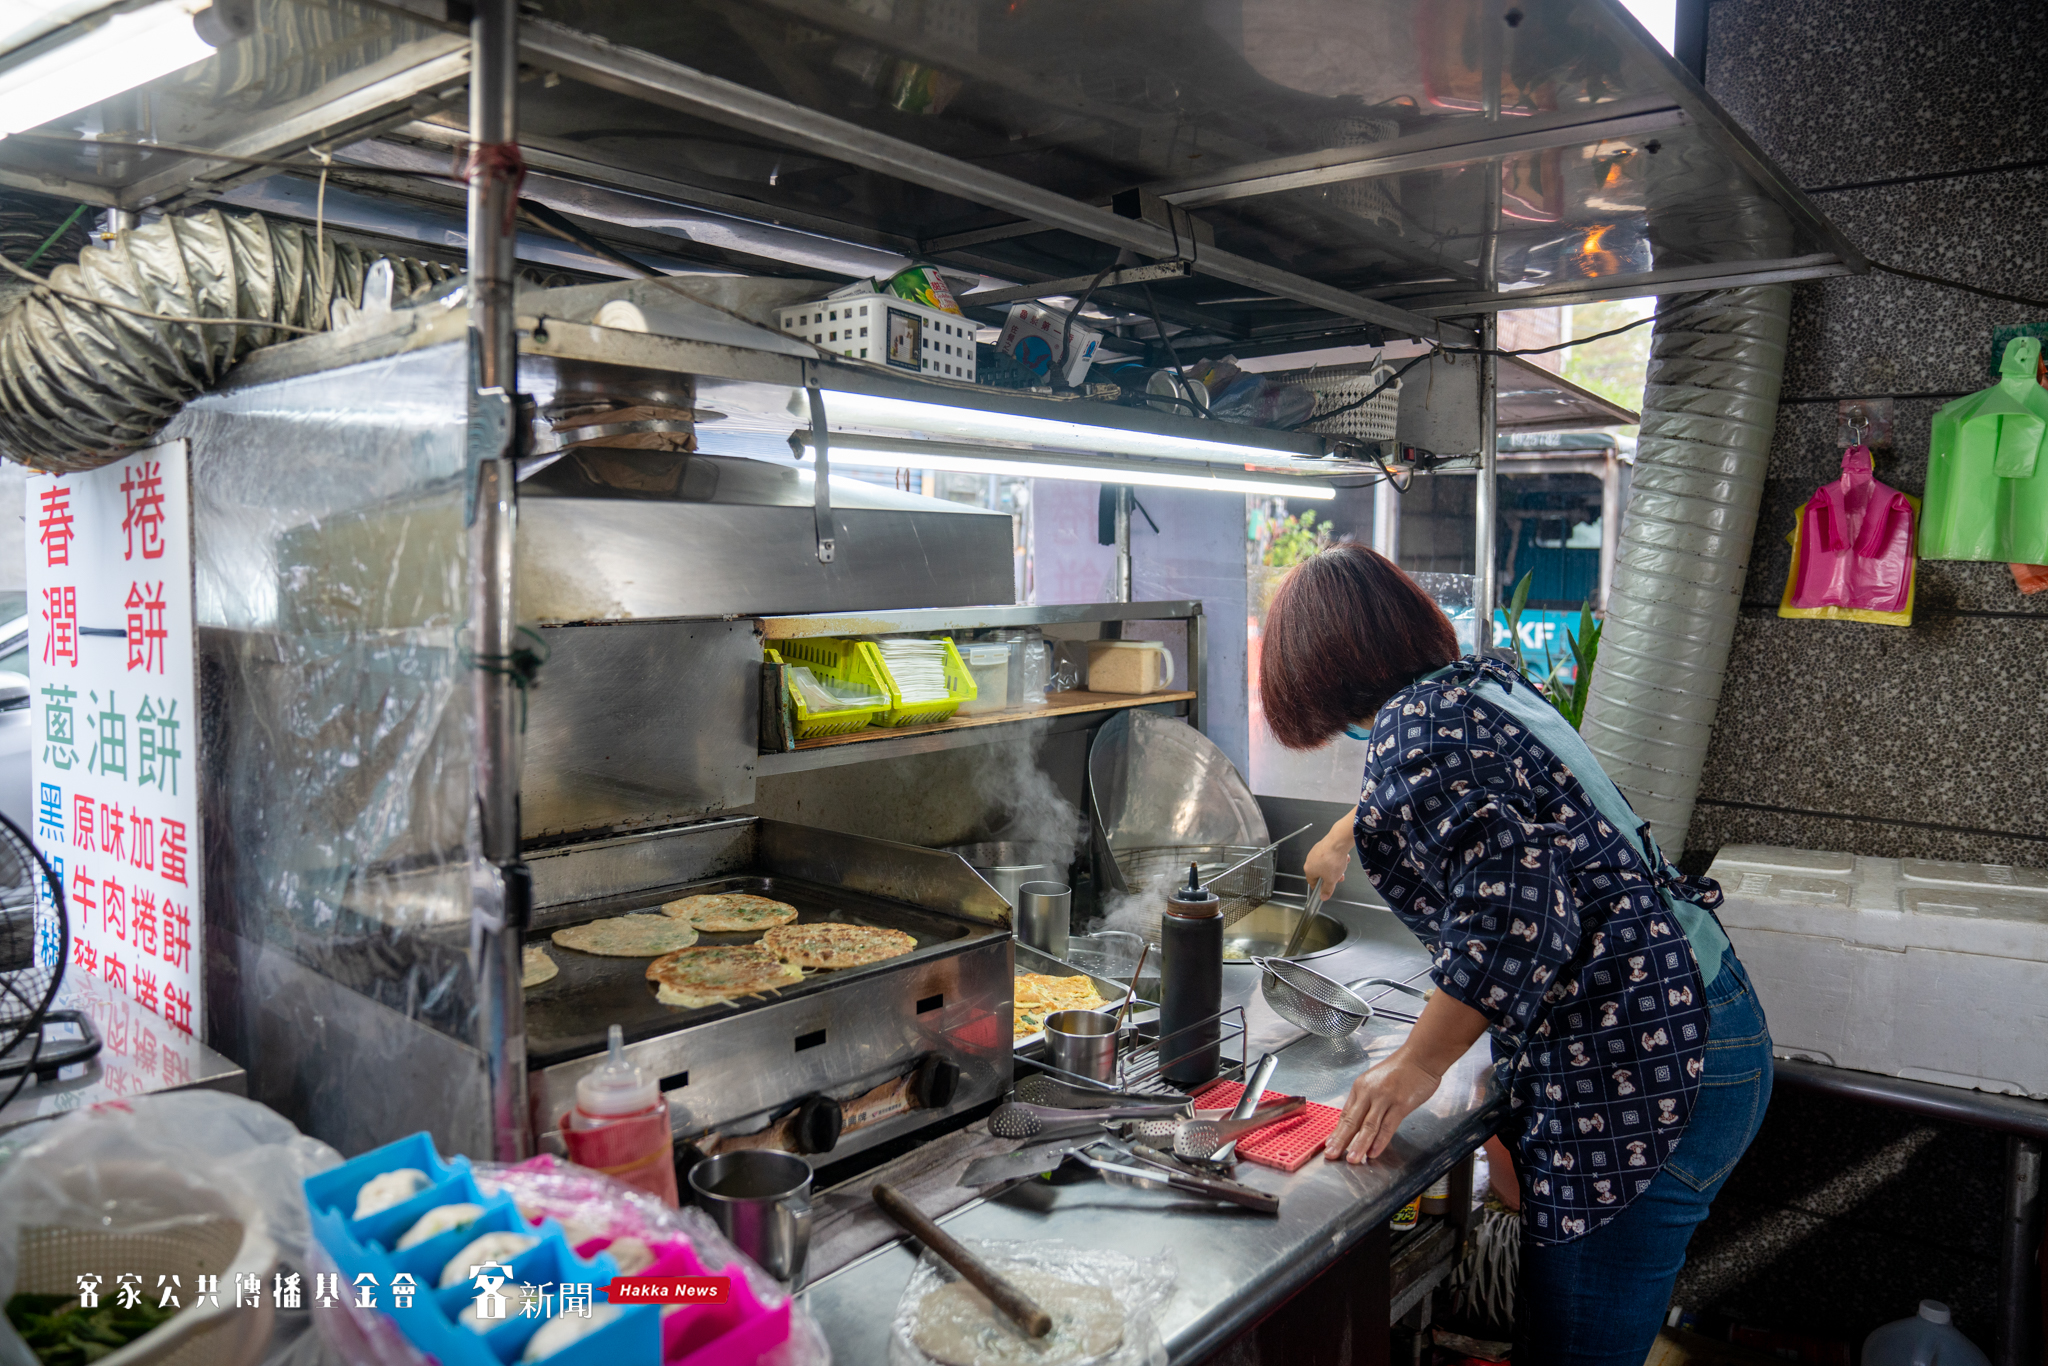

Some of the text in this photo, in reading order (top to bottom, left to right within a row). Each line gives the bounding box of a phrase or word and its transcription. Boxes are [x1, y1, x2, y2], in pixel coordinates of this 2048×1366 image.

[41, 682, 182, 796] 蔥油餅
[73, 793, 189, 889] 原味加蛋
[72, 864, 192, 975] 牛肉捲餅
